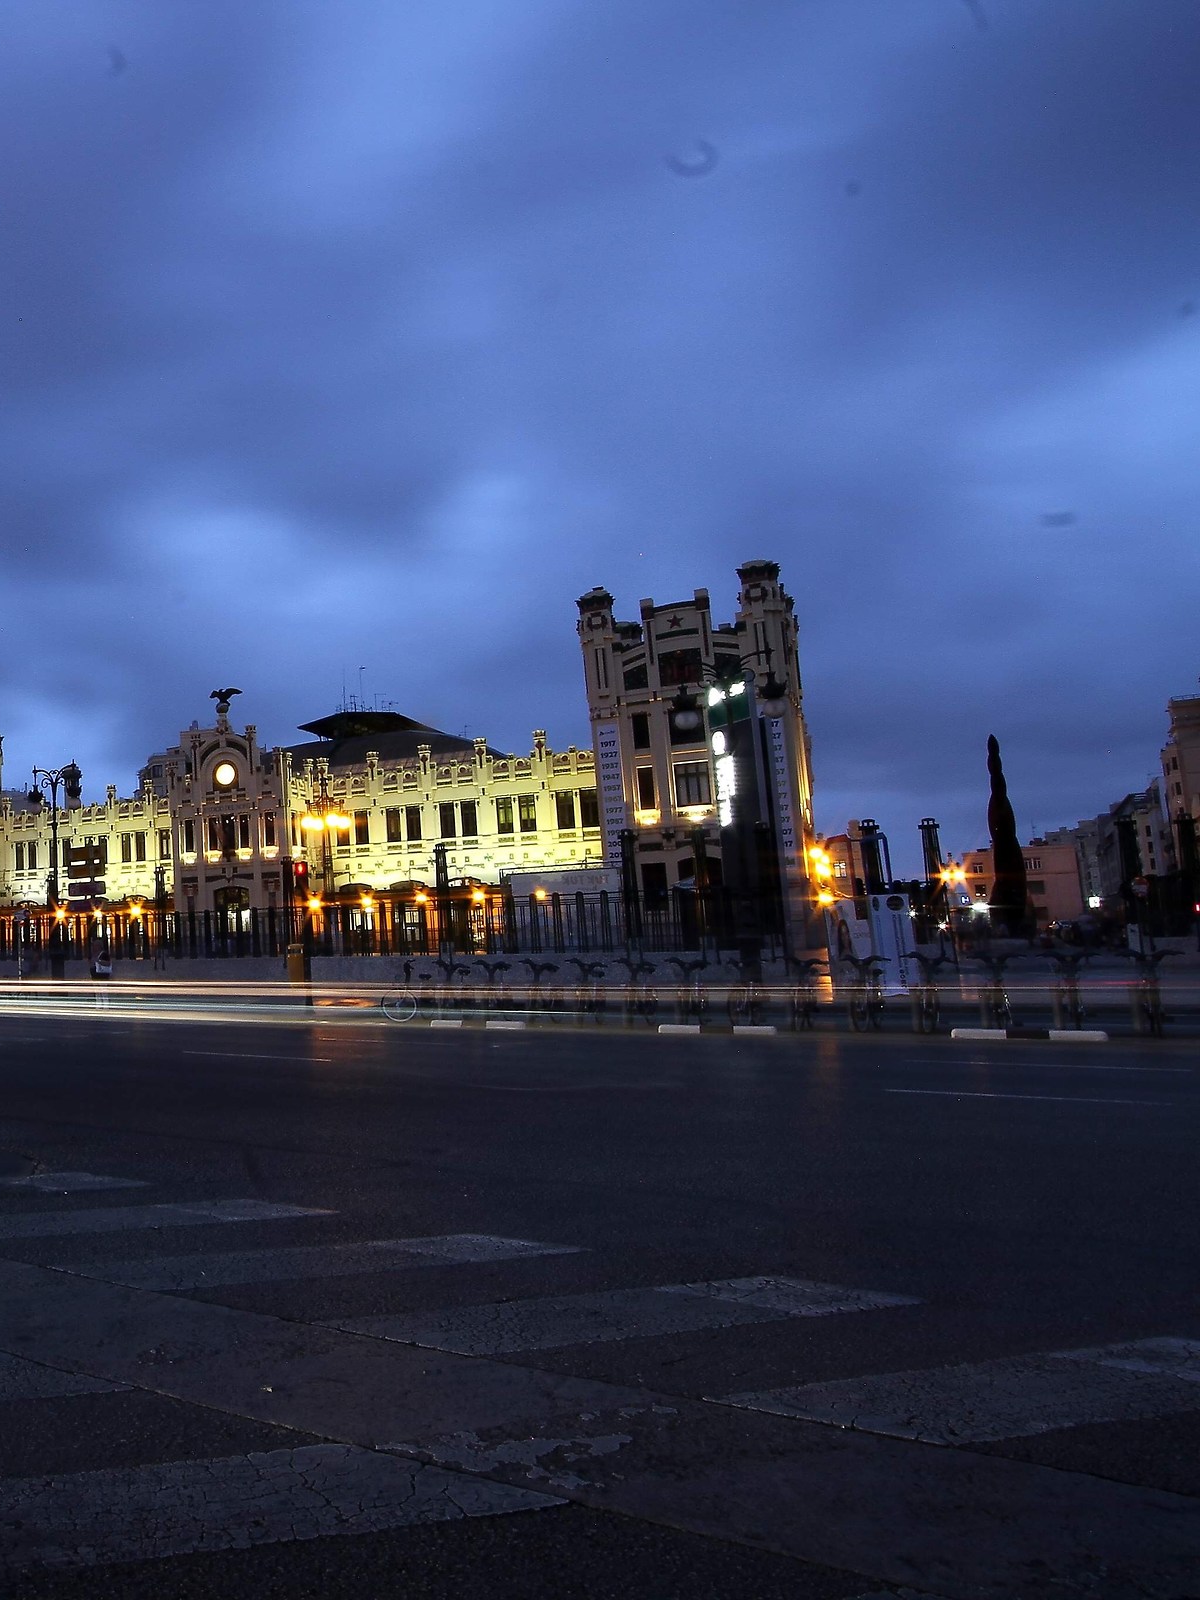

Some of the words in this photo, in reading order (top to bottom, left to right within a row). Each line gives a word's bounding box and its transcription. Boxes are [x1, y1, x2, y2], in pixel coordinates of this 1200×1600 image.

[600, 740, 616, 748] 1917
[601, 762, 619, 770] 1937
[602, 773, 620, 781] 1947
[603, 784, 621, 792] 1957
[606, 806, 623, 814] 1977
[607, 840, 622, 848] 200
